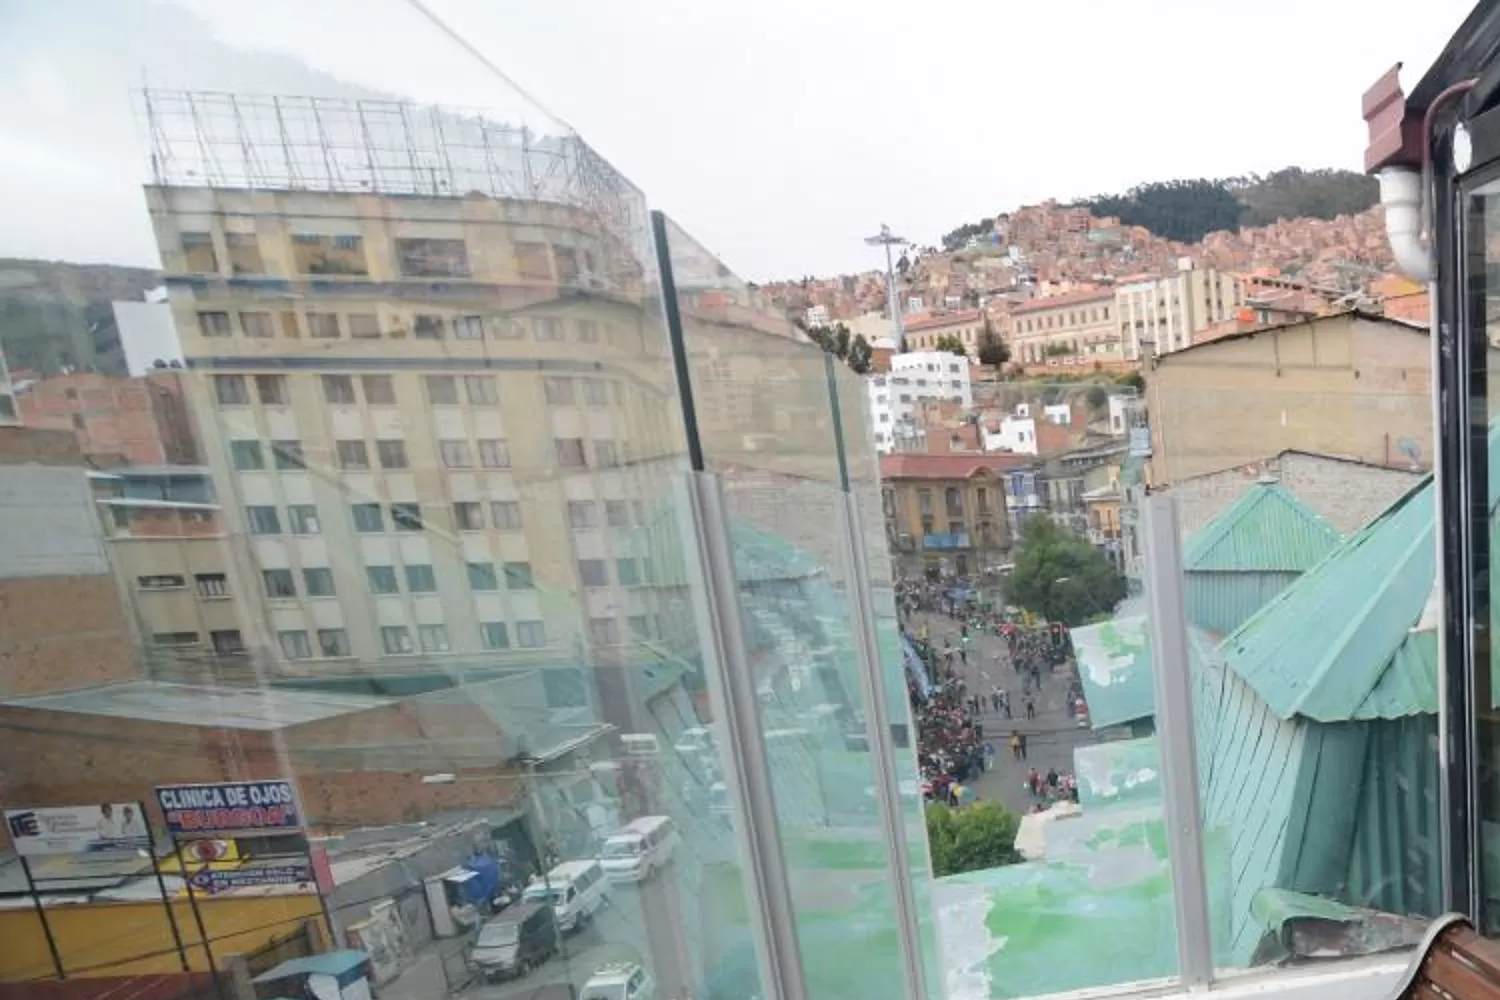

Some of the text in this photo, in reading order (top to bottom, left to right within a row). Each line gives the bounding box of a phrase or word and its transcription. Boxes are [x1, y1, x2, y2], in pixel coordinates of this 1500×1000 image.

[160, 783, 292, 808] CLINICA DE OJOS
